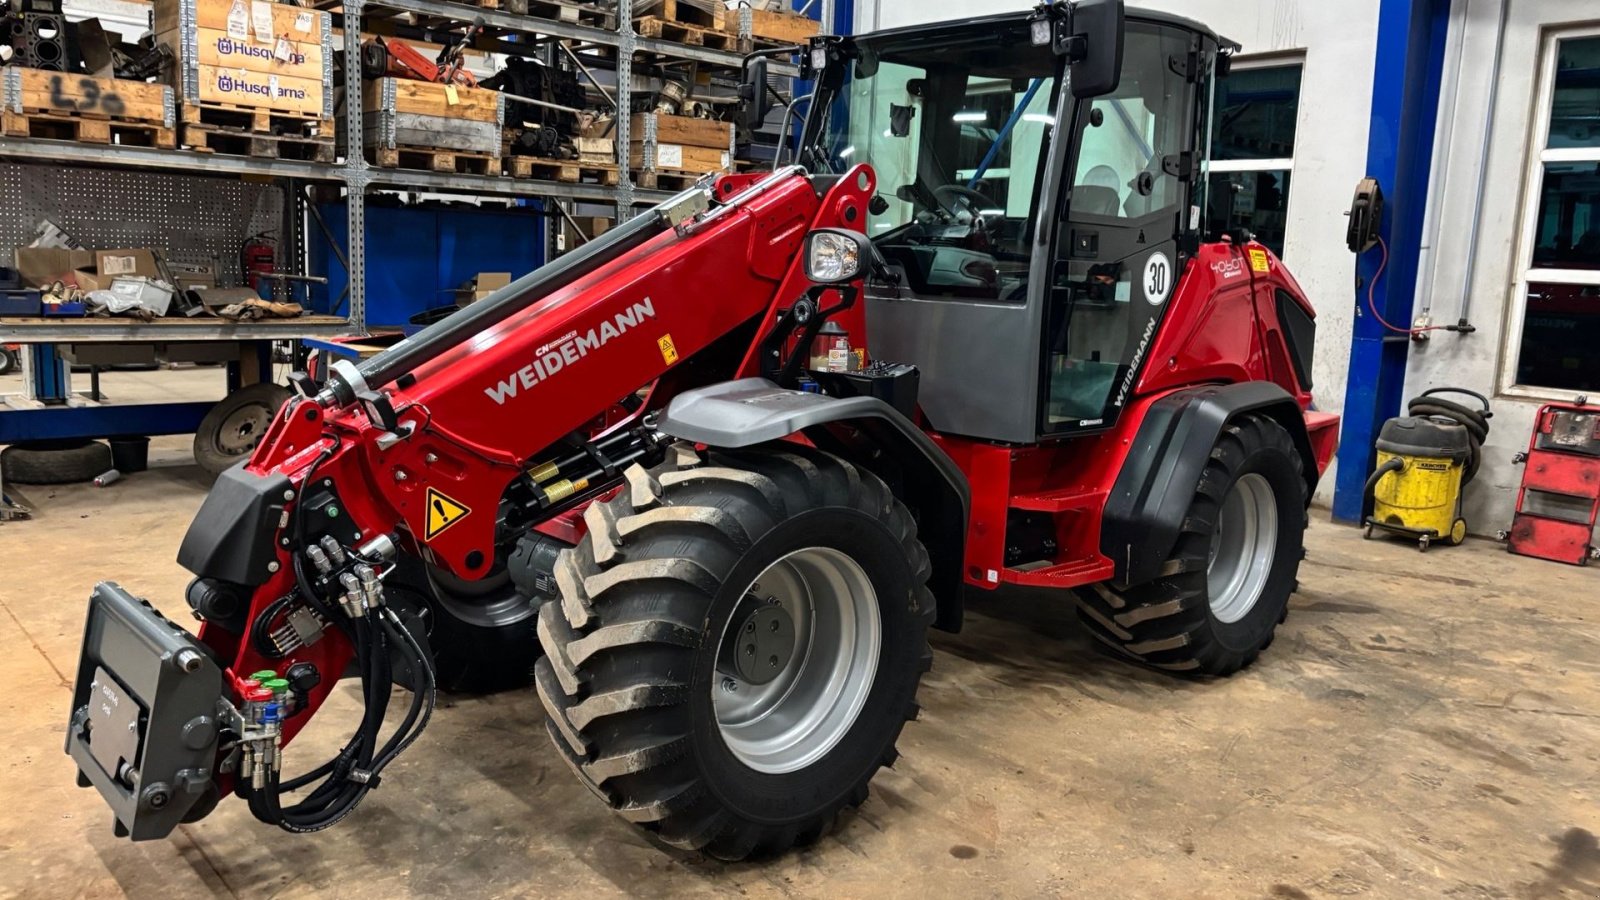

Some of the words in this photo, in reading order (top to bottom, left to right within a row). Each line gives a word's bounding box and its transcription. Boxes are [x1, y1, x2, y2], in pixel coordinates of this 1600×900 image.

[234, 42, 304, 64] Husqvna
[234, 79, 304, 99] Husqarna
[1148, 262, 1165, 296] 30
[484, 297, 655, 405] WEIDEMANN
[1114, 316, 1156, 407] WEIDEMANN
